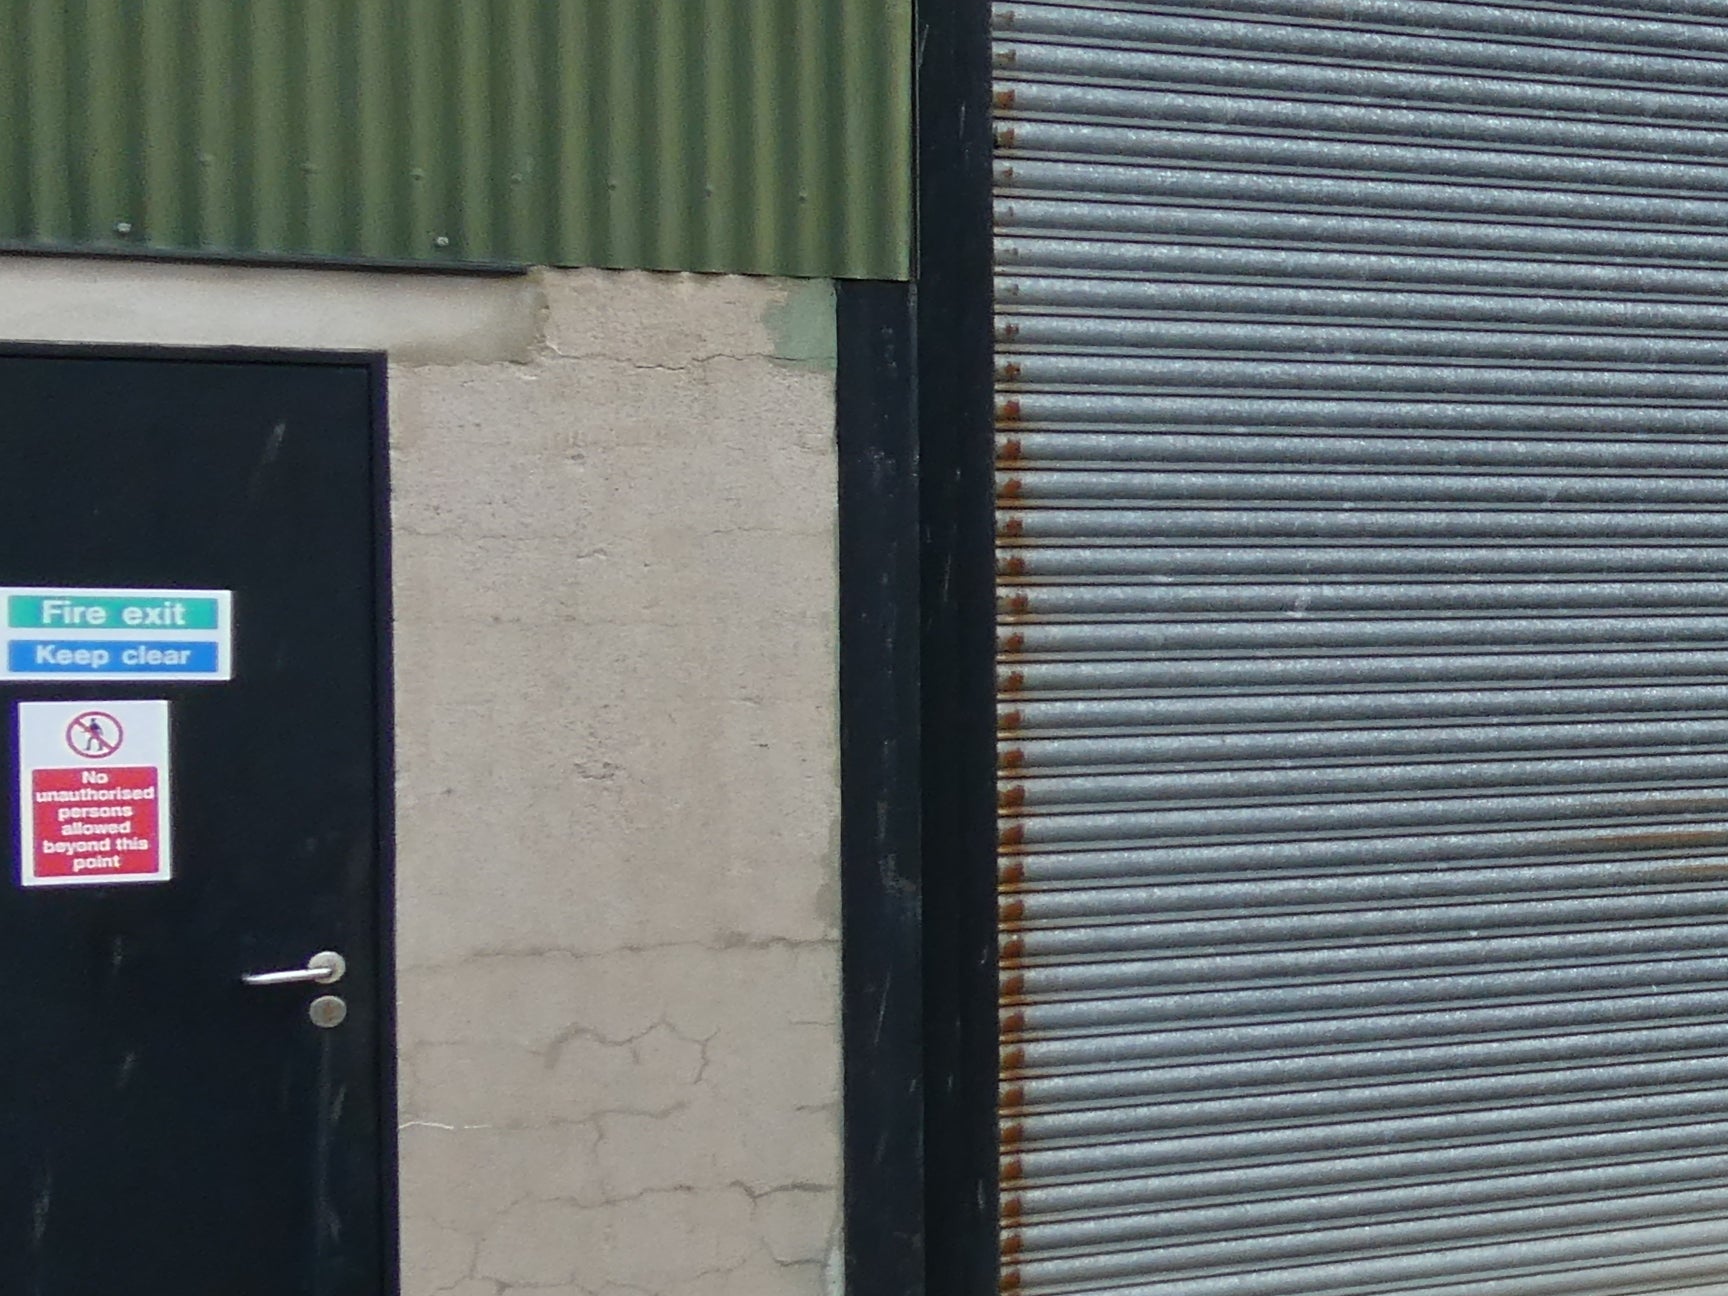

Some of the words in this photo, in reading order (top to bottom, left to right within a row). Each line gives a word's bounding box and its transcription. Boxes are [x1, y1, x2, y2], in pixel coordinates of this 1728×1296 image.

[41, 599, 106, 624] Fire
[121, 600, 187, 626] exit
[36, 644, 110, 668] Keep
[121, 645, 192, 666] clear
[81, 770, 109, 784] No
[36, 786, 155, 802] unauthorised
[57, 805, 133, 821] persons
[61, 820, 131, 835] allowed
[43, 837, 111, 855] beyond
[115, 836, 149, 851] this
[72, 855, 121, 872] point
